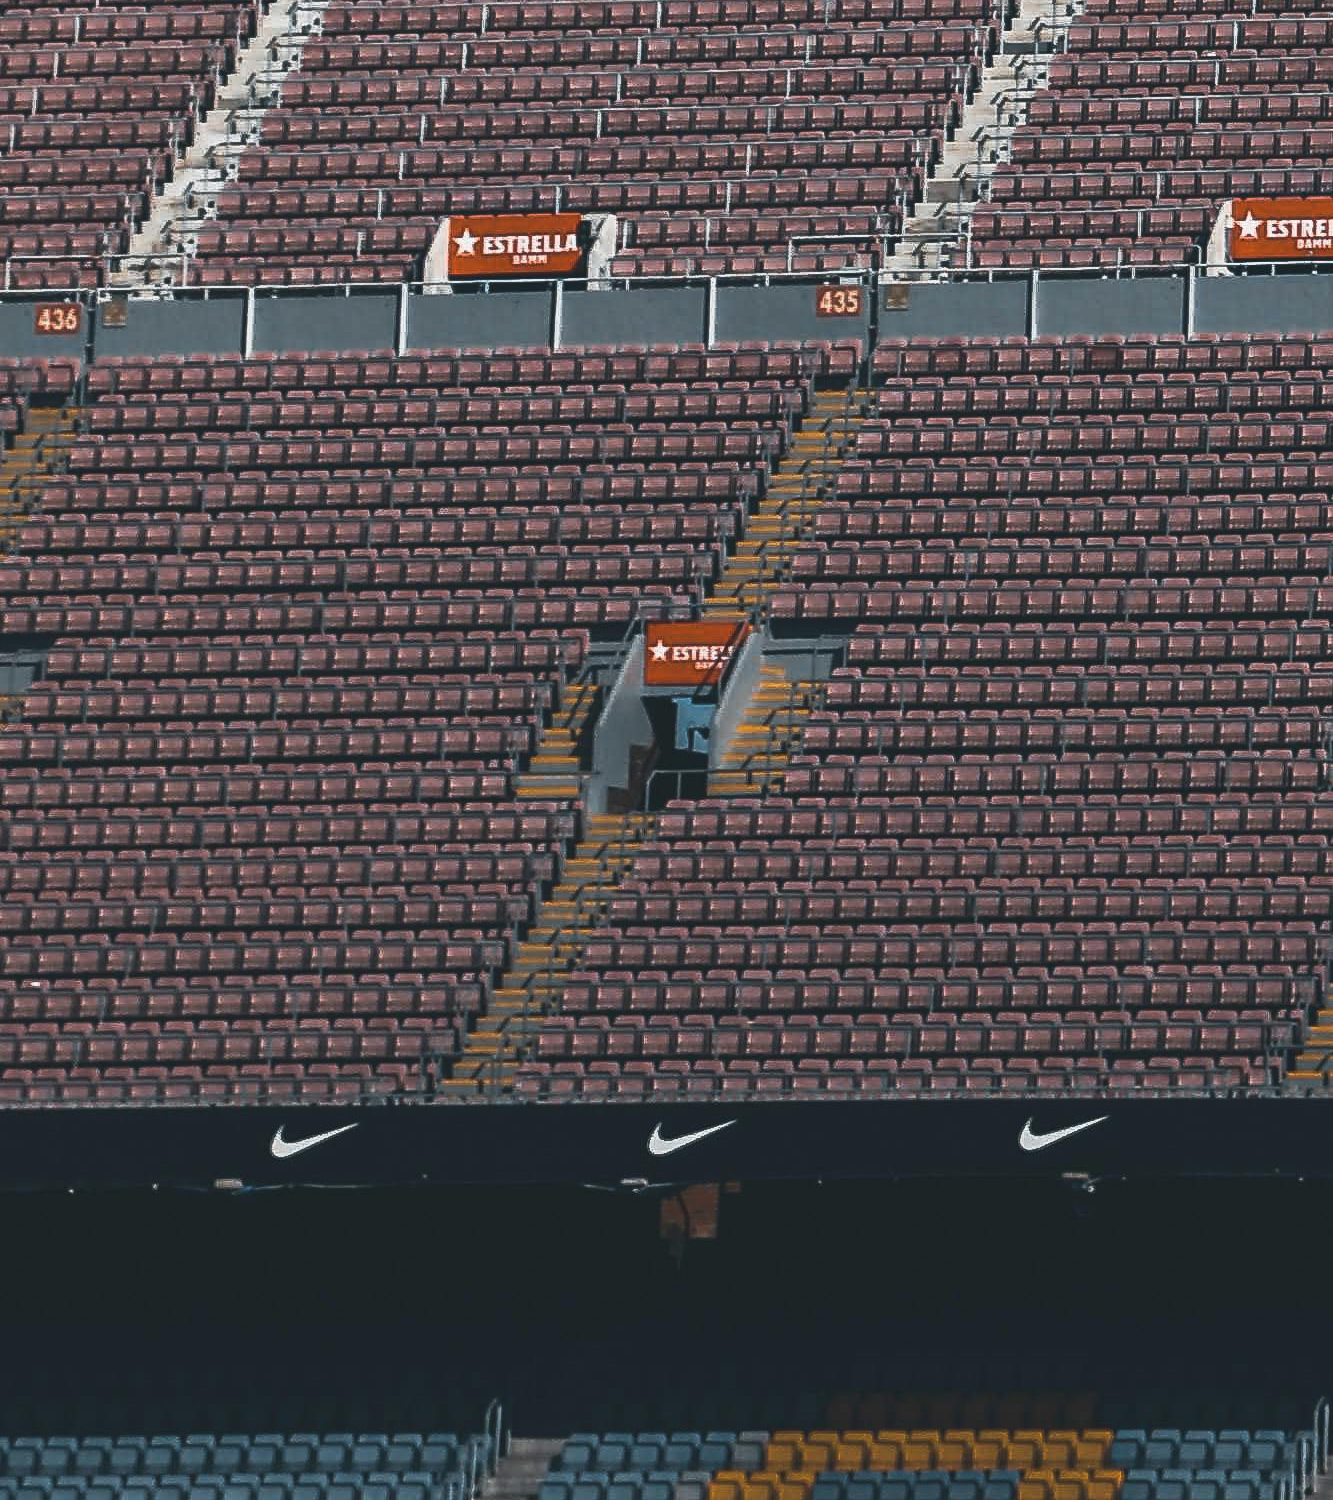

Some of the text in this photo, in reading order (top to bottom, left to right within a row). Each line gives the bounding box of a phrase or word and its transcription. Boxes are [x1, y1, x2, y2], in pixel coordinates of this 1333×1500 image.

[482, 233, 578, 255] ESTRELLA
[1296, 238, 1333, 249] DAMM
[819, 289, 859, 314] 435
[37, 307, 78, 331] 436
